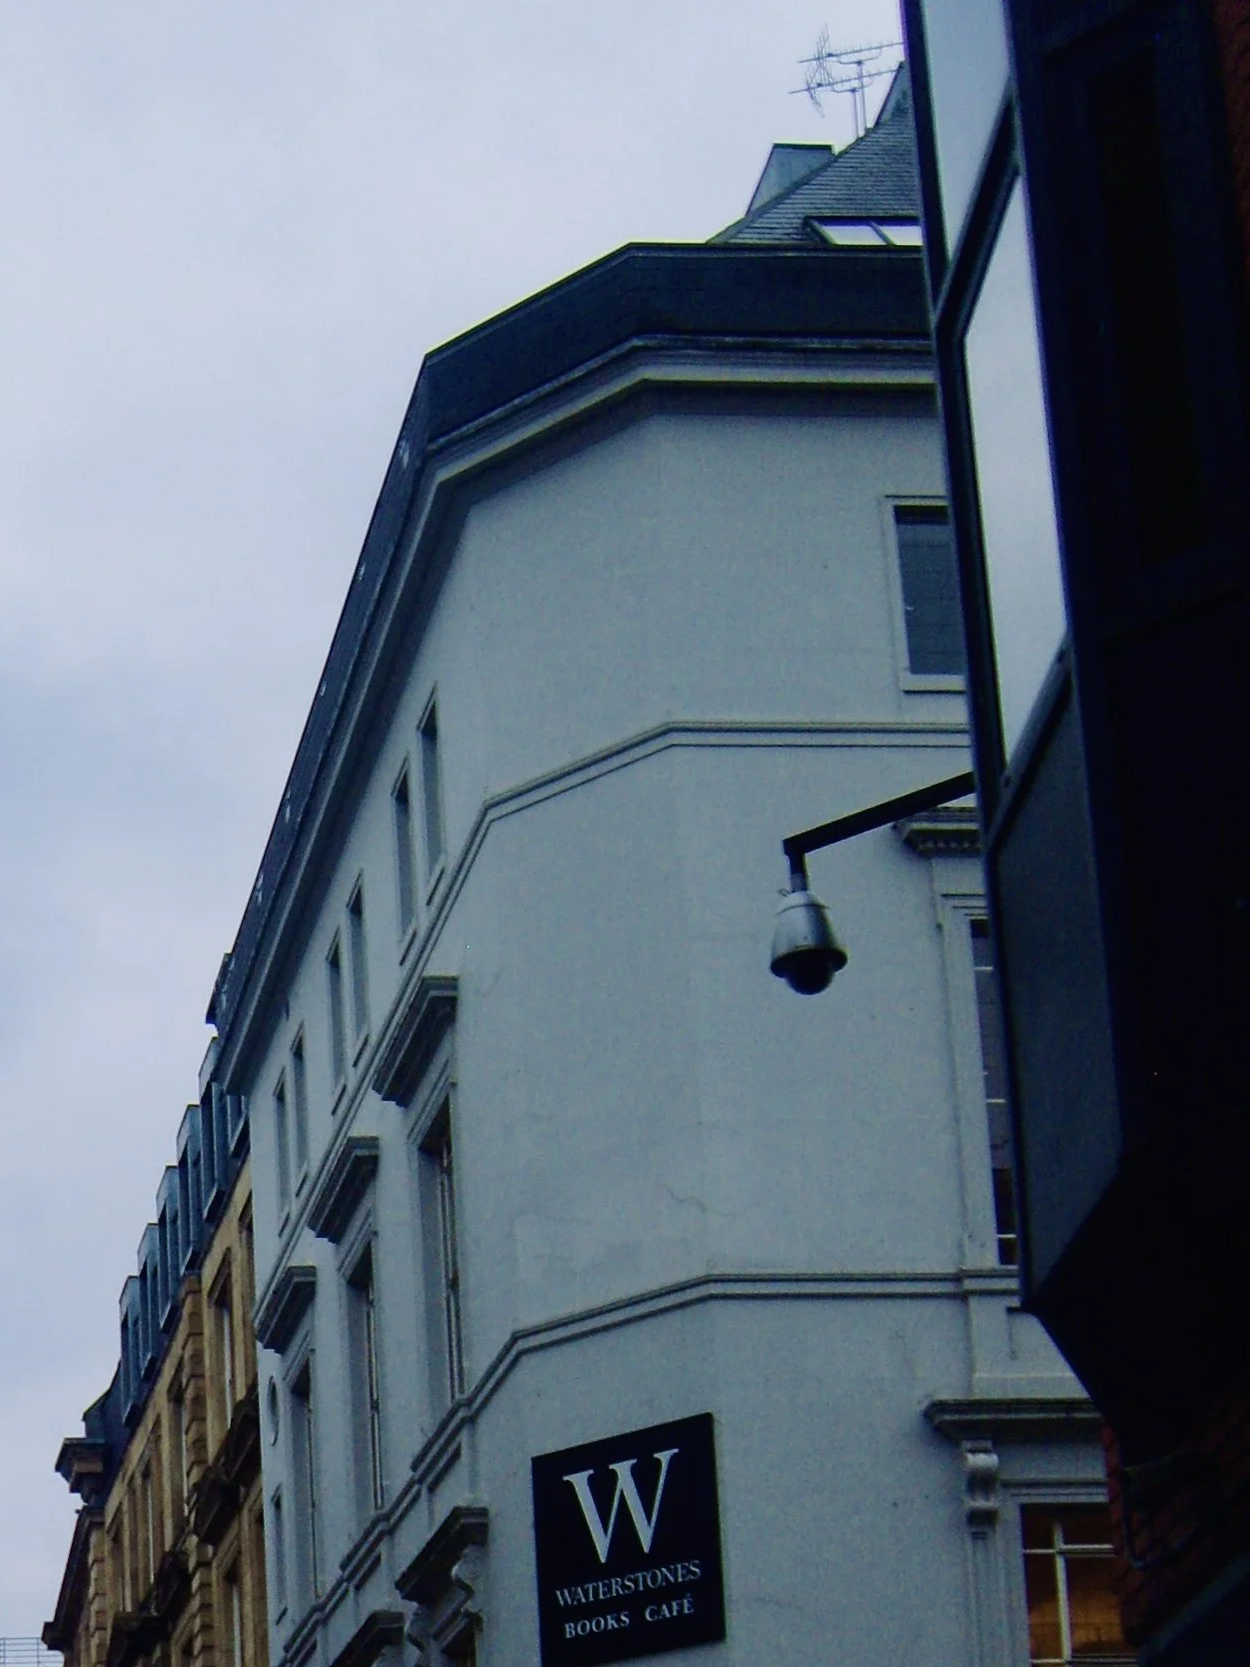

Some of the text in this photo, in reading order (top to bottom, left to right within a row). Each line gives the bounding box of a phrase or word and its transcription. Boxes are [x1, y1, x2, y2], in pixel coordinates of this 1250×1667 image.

[562, 1448, 680, 1564] W
[555, 1559, 702, 1607] WATERSTONES
[564, 1592, 695, 1639] BOOKS CAFÉ
